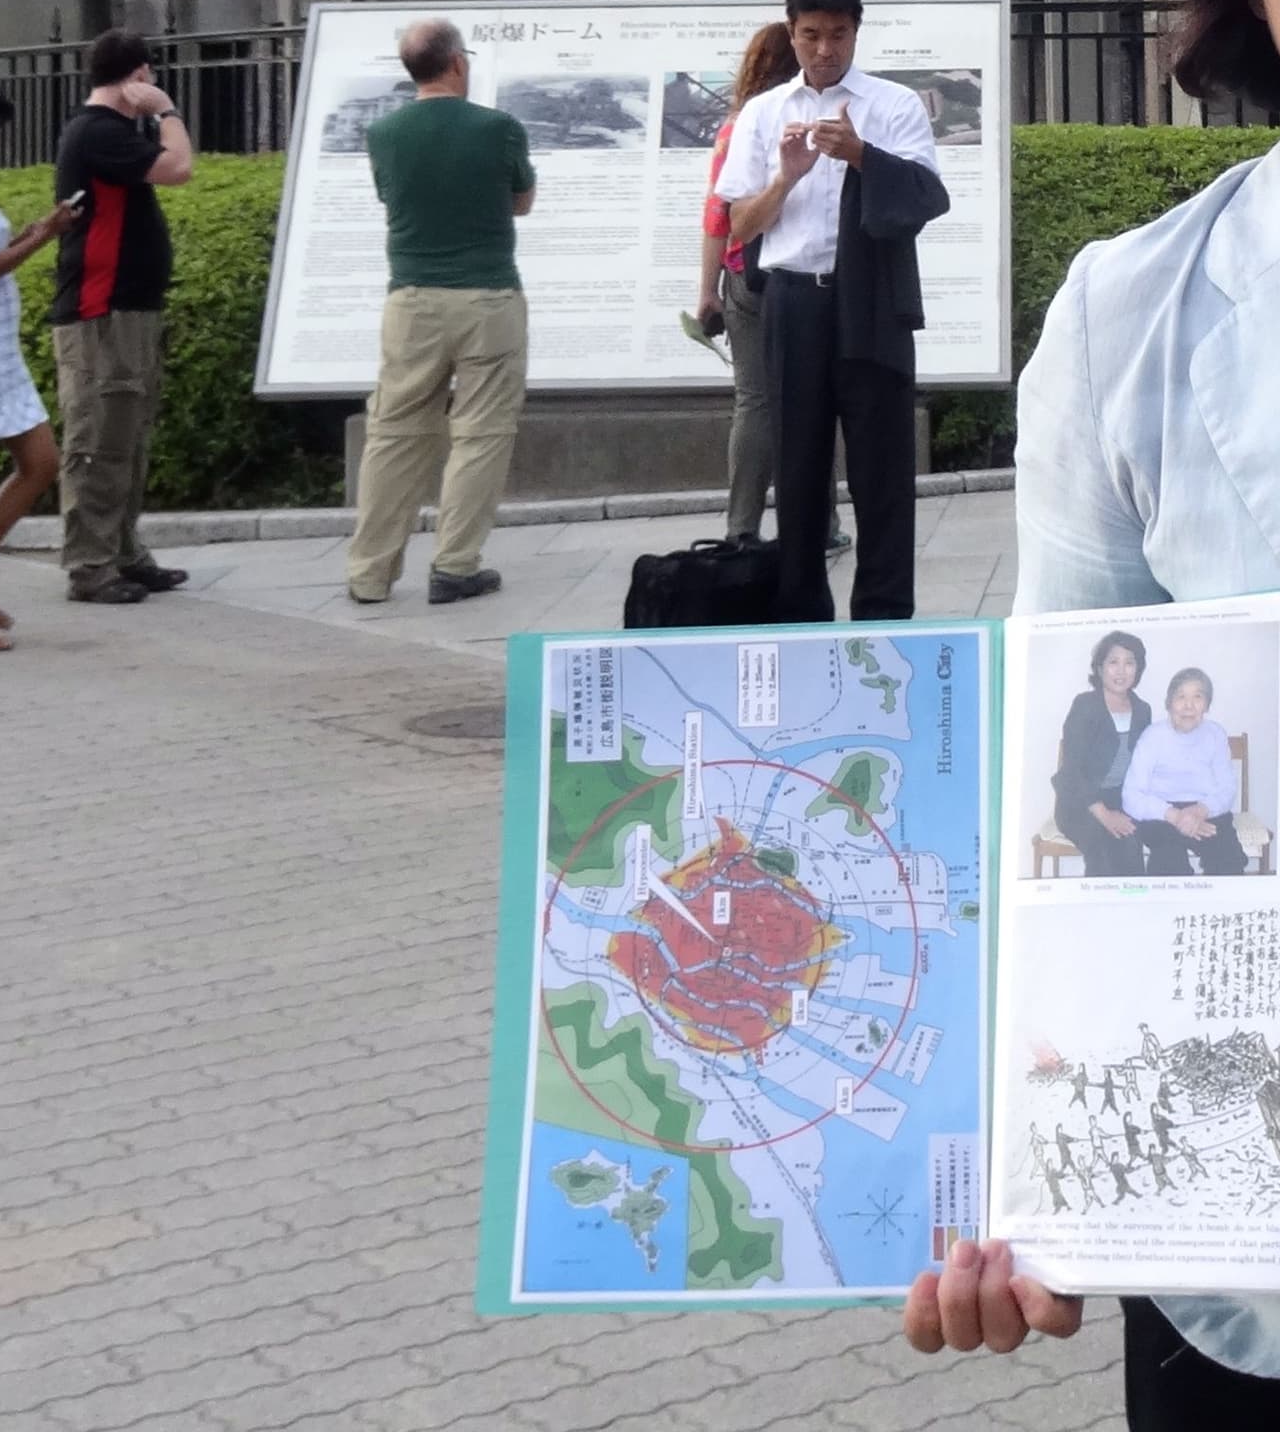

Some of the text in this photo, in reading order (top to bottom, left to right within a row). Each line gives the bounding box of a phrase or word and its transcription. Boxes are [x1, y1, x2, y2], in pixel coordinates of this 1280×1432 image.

[471, 22, 602, 42] 原爆ドーム
[936, 643, 954, 775] Hiroshima City
[686, 723, 697, 815] Hiroshima Station
[637, 839, 648, 896] Hypocenter
[1084, 1221, 1100, 1230] that
[1105, 1221, 1118, 1230] the
[1123, 1223, 1162, 1231] survivors
[1167, 1221, 1176, 1230] of
[1179, 1221, 1192, 1230] the
[1095, 1236, 1108, 1245] the
[1133, 1237, 1148, 1246] and
[1152, 1237, 1165, 1246] the
[1228, 1239, 1236, 1247] of
[1240, 1239, 1257, 1247] that
